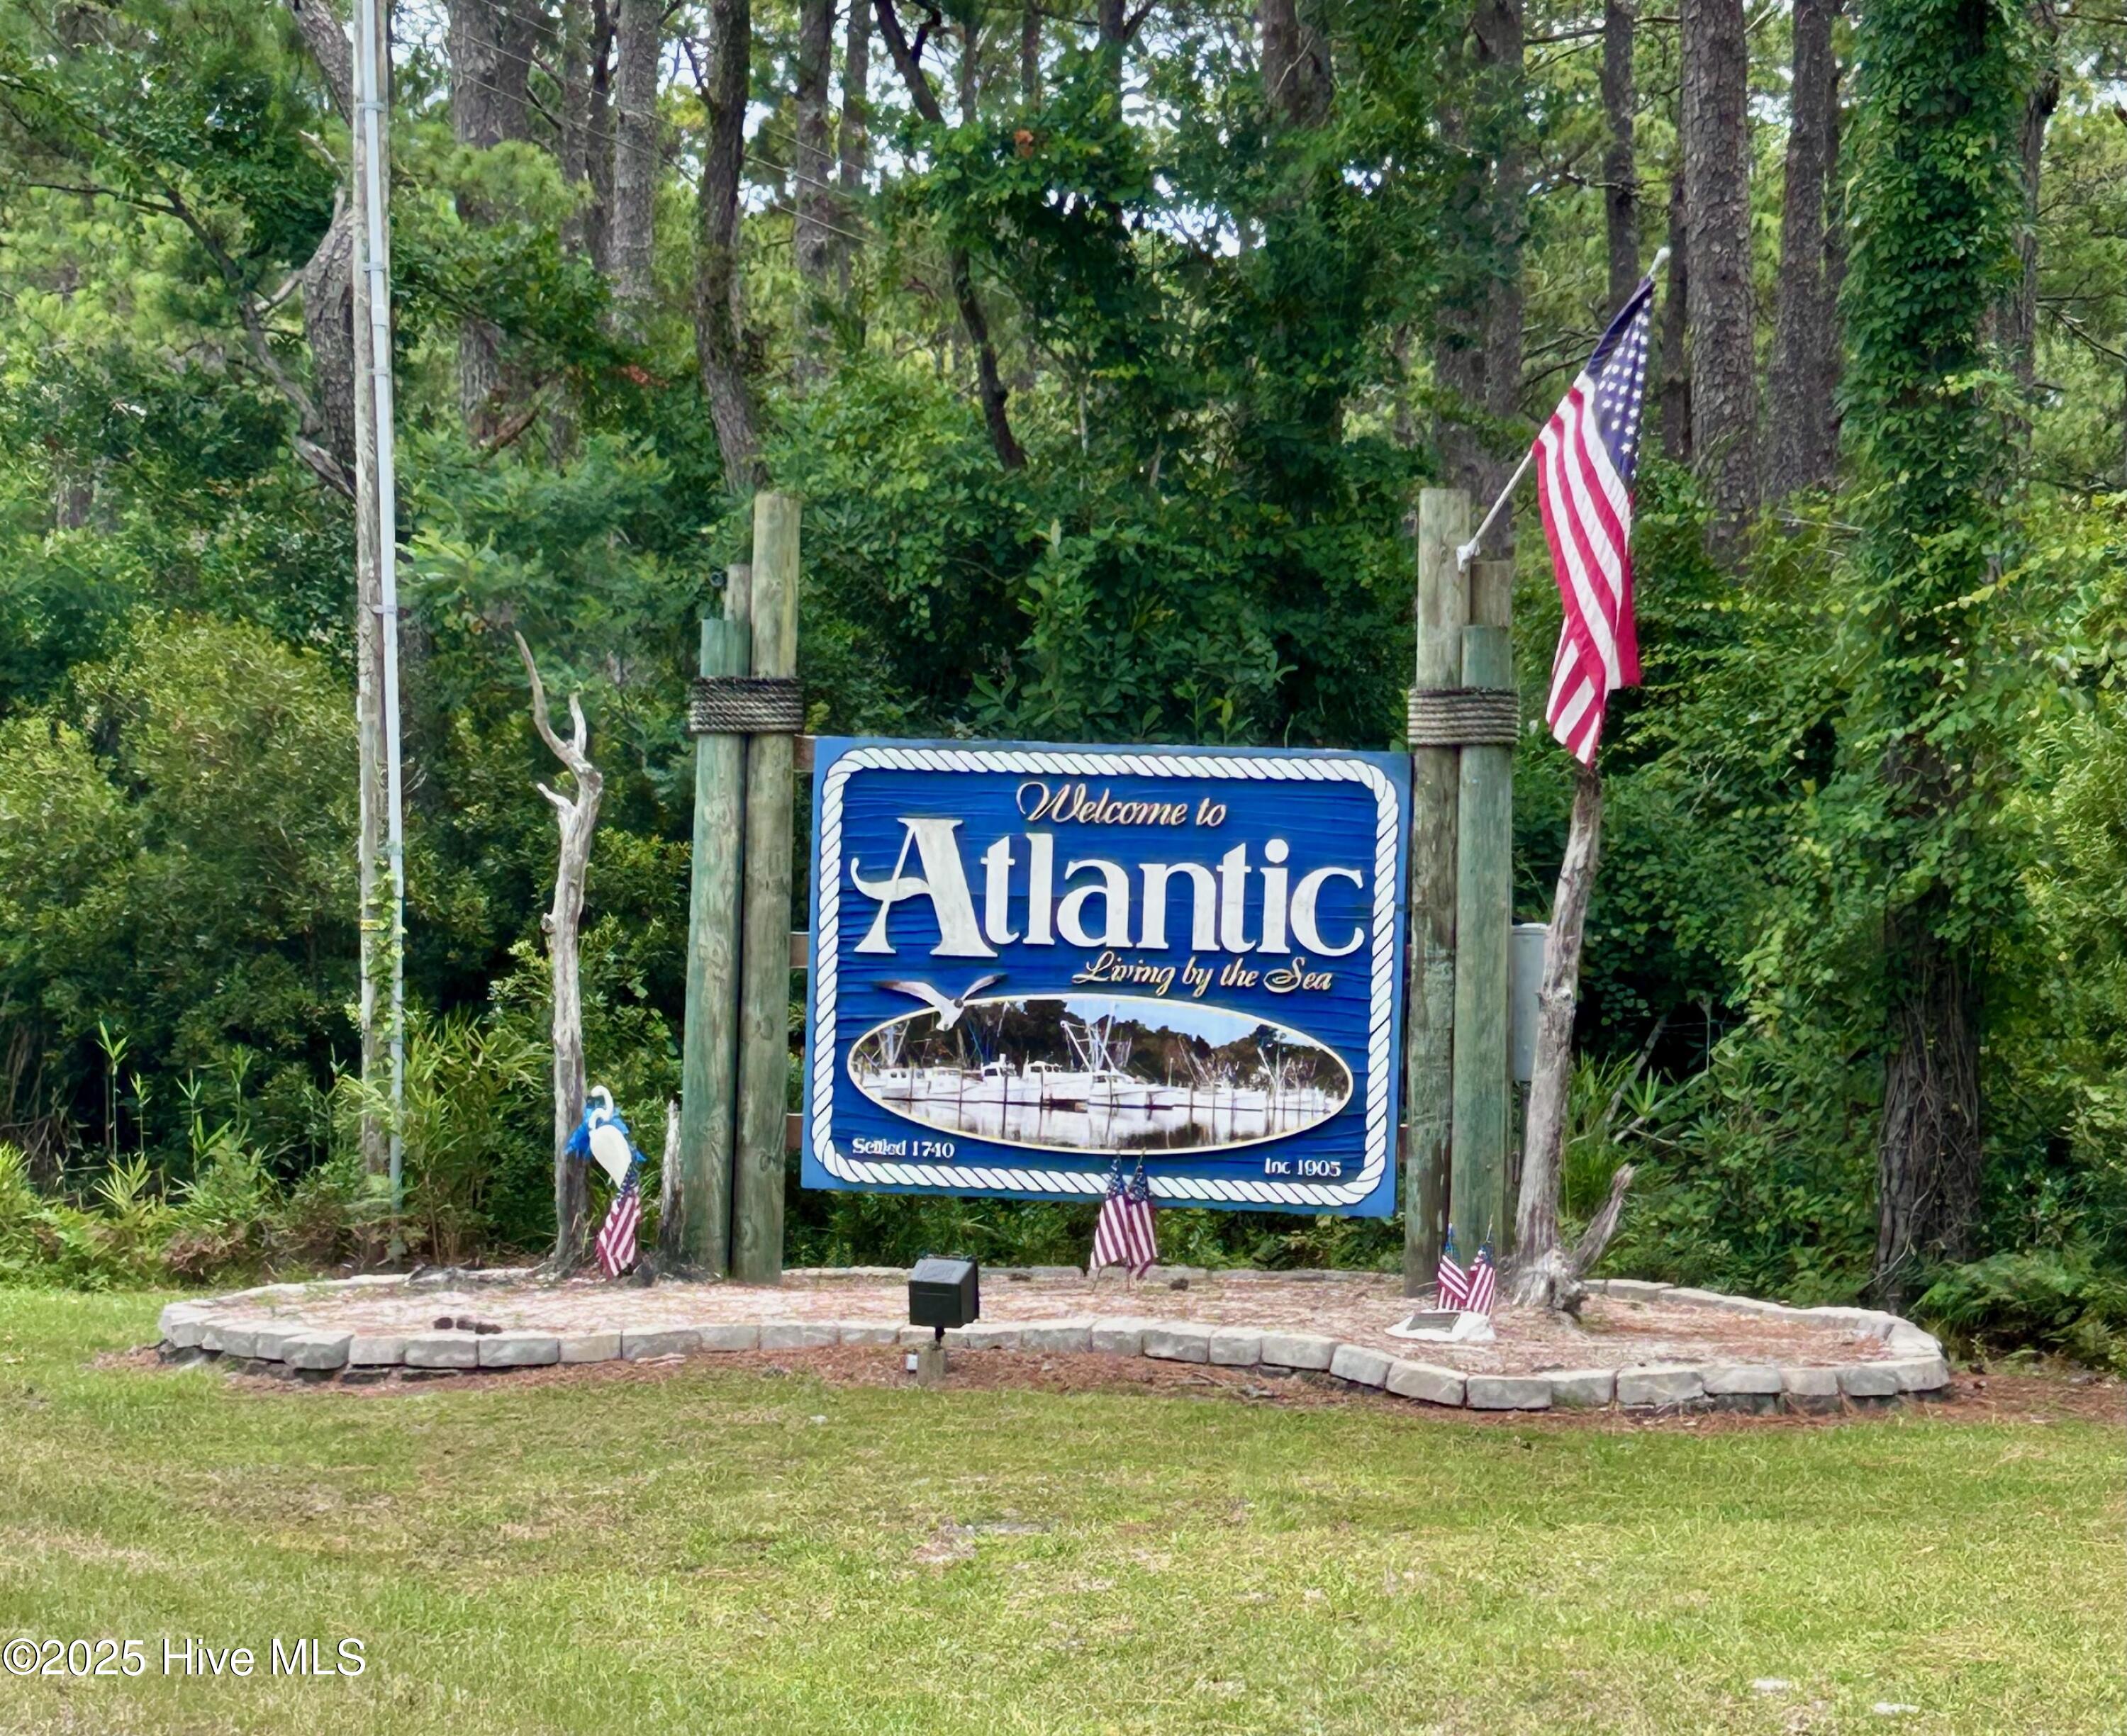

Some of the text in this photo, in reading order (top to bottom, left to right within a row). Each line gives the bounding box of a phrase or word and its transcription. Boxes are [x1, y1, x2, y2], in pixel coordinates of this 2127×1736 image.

[1016, 781, 1227, 827] Welcome to
[851, 817, 1366, 958] Atlantic
[1071, 951, 1333, 997] Living by the Sea
[912, 1141, 955, 1158] 1740
[1265, 1158, 1342, 1177] Inc 1905
